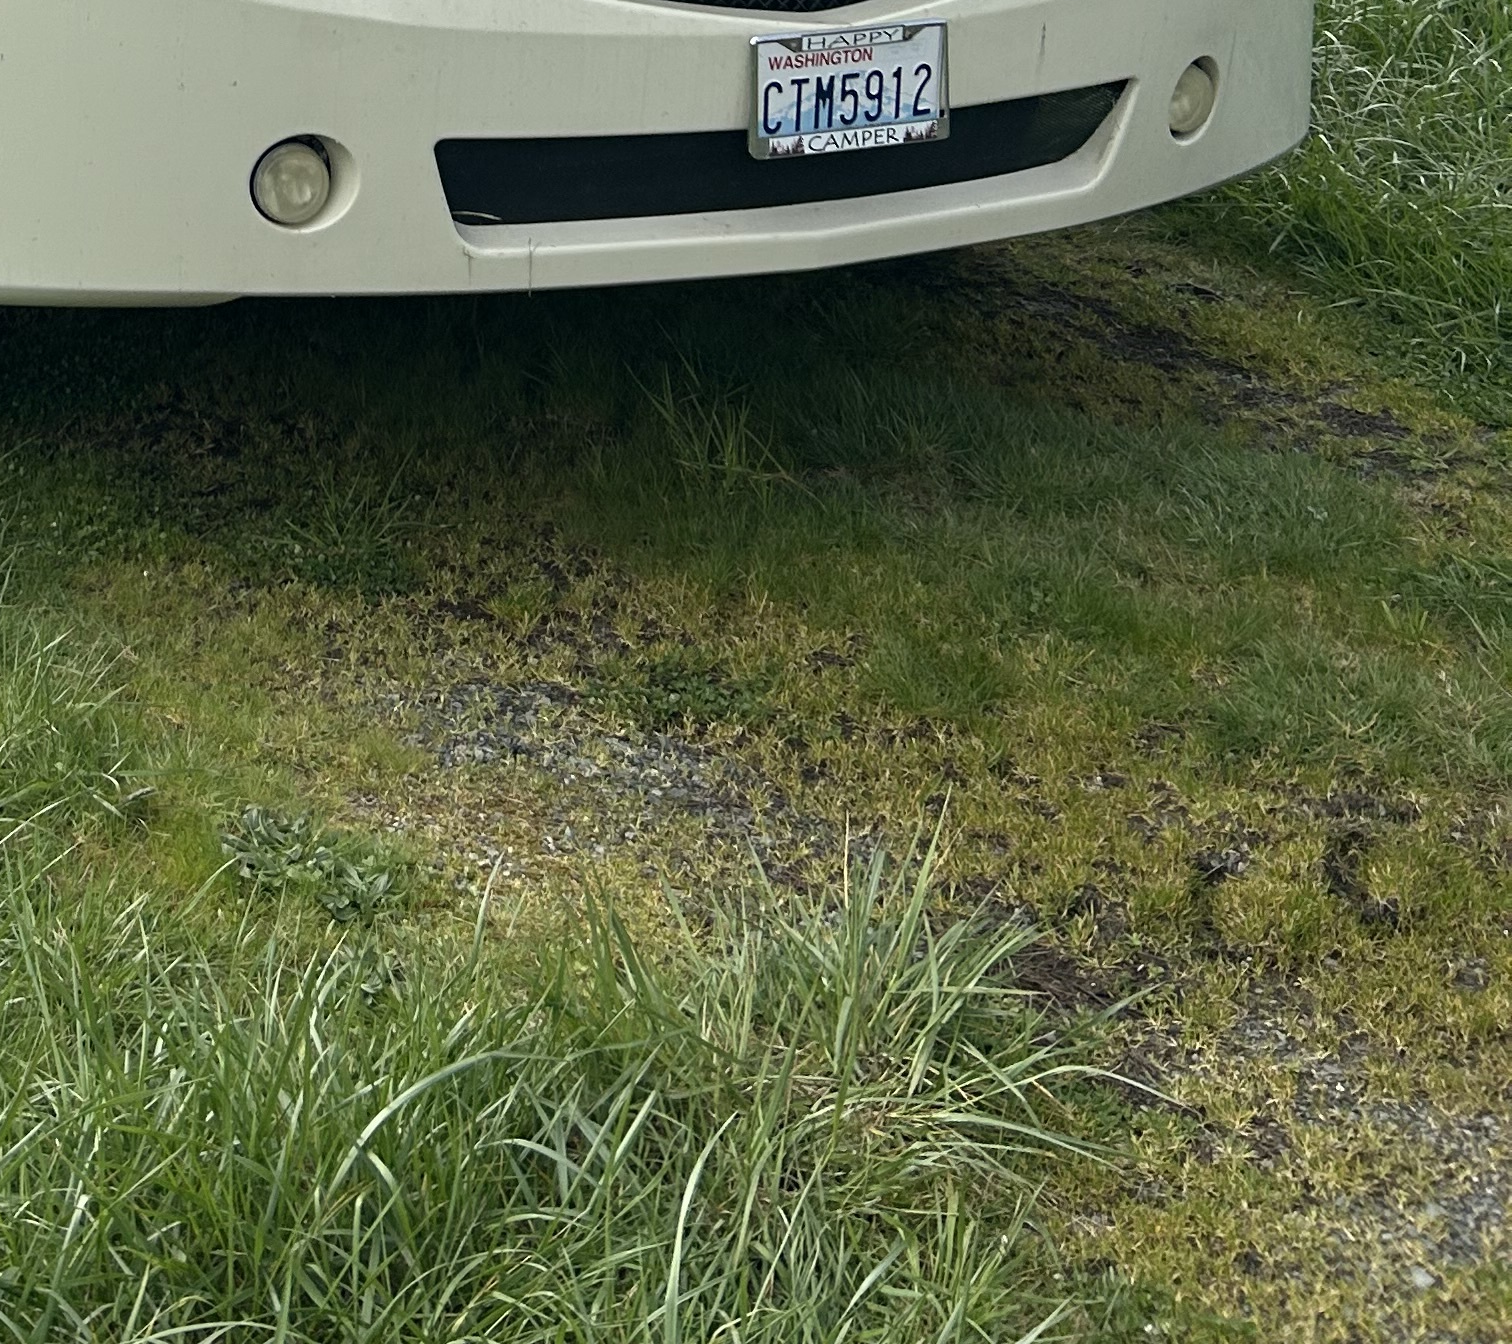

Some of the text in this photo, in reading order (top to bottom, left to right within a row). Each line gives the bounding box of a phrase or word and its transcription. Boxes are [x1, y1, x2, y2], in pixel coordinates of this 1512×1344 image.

[807, 28, 899, 50] HAPPY
[768, 47, 873, 71] WASHINGTON
[763, 63, 932, 135] CTM5912
[808, 127, 900, 152] CAMPER
